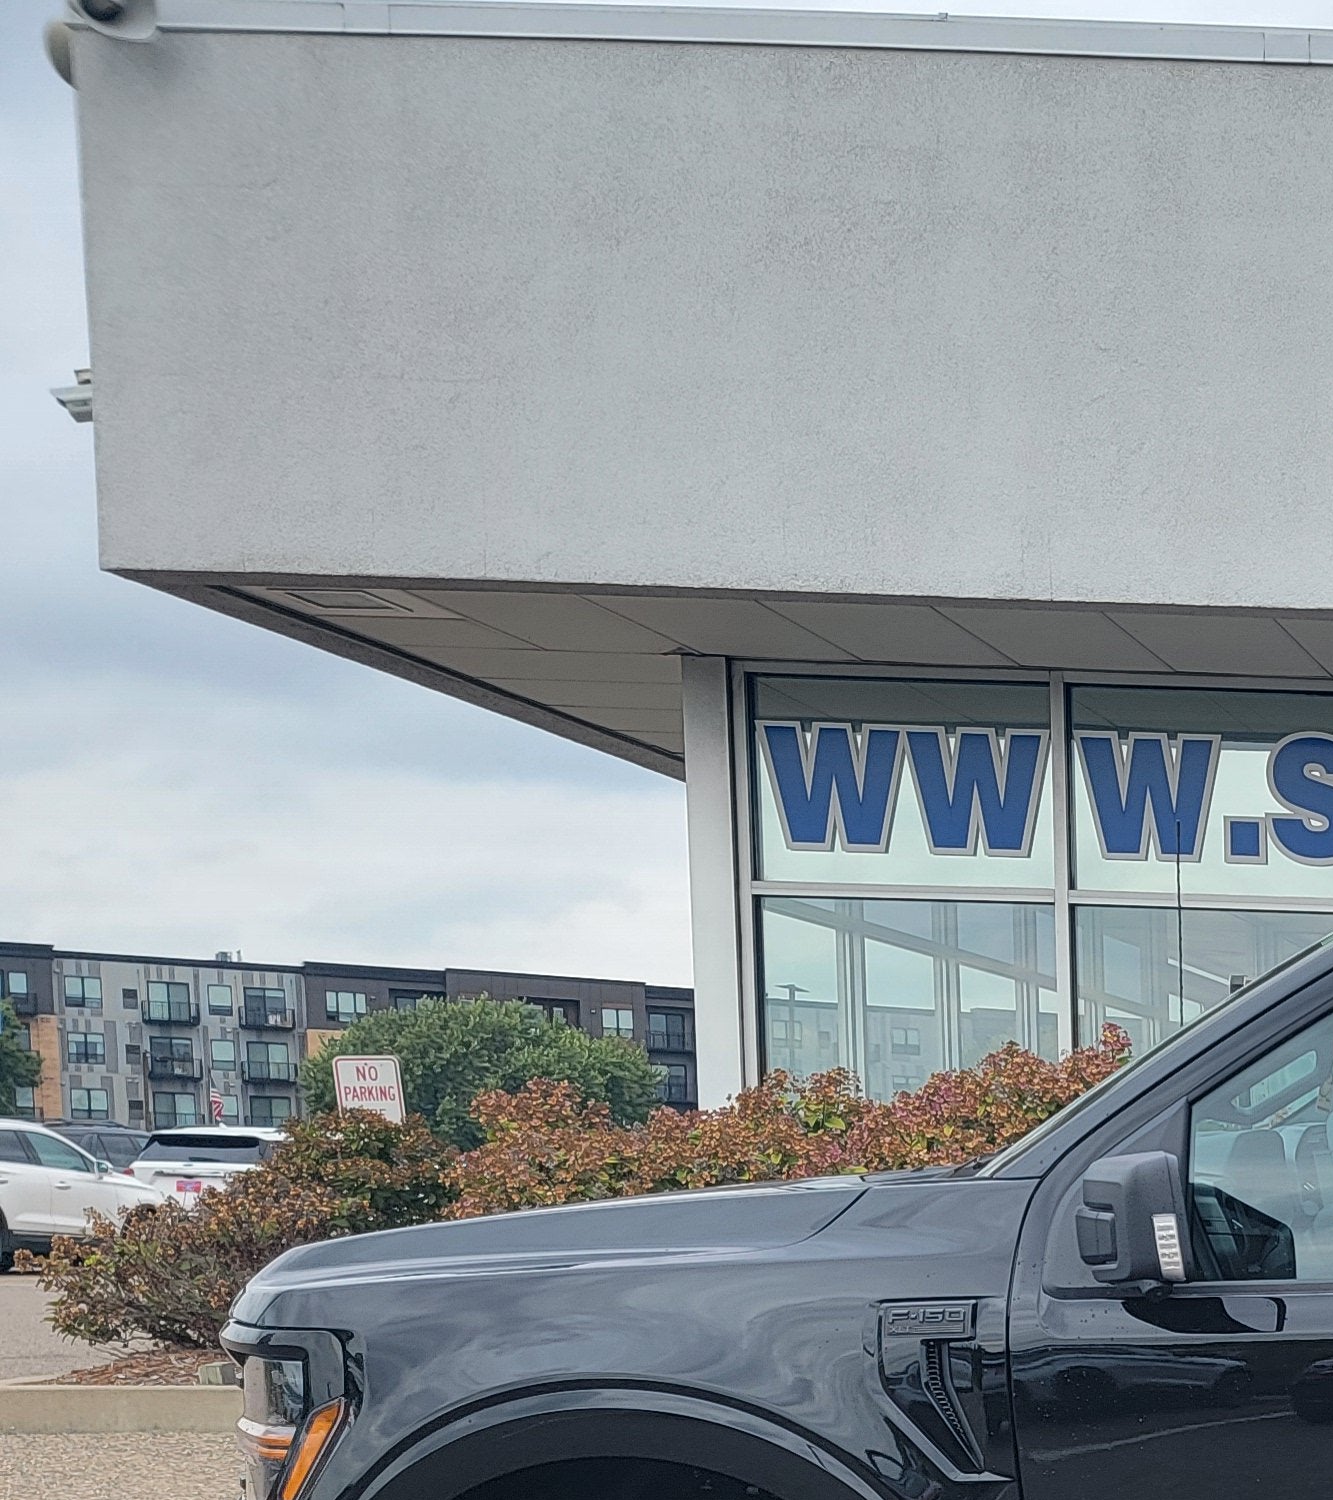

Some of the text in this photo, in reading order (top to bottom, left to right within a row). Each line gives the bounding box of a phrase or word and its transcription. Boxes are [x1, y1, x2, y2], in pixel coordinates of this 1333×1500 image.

[355, 1066, 378, 1081] NO
[344, 1086, 396, 1101] PARKING
[888, 1308, 966, 1324] F-150
